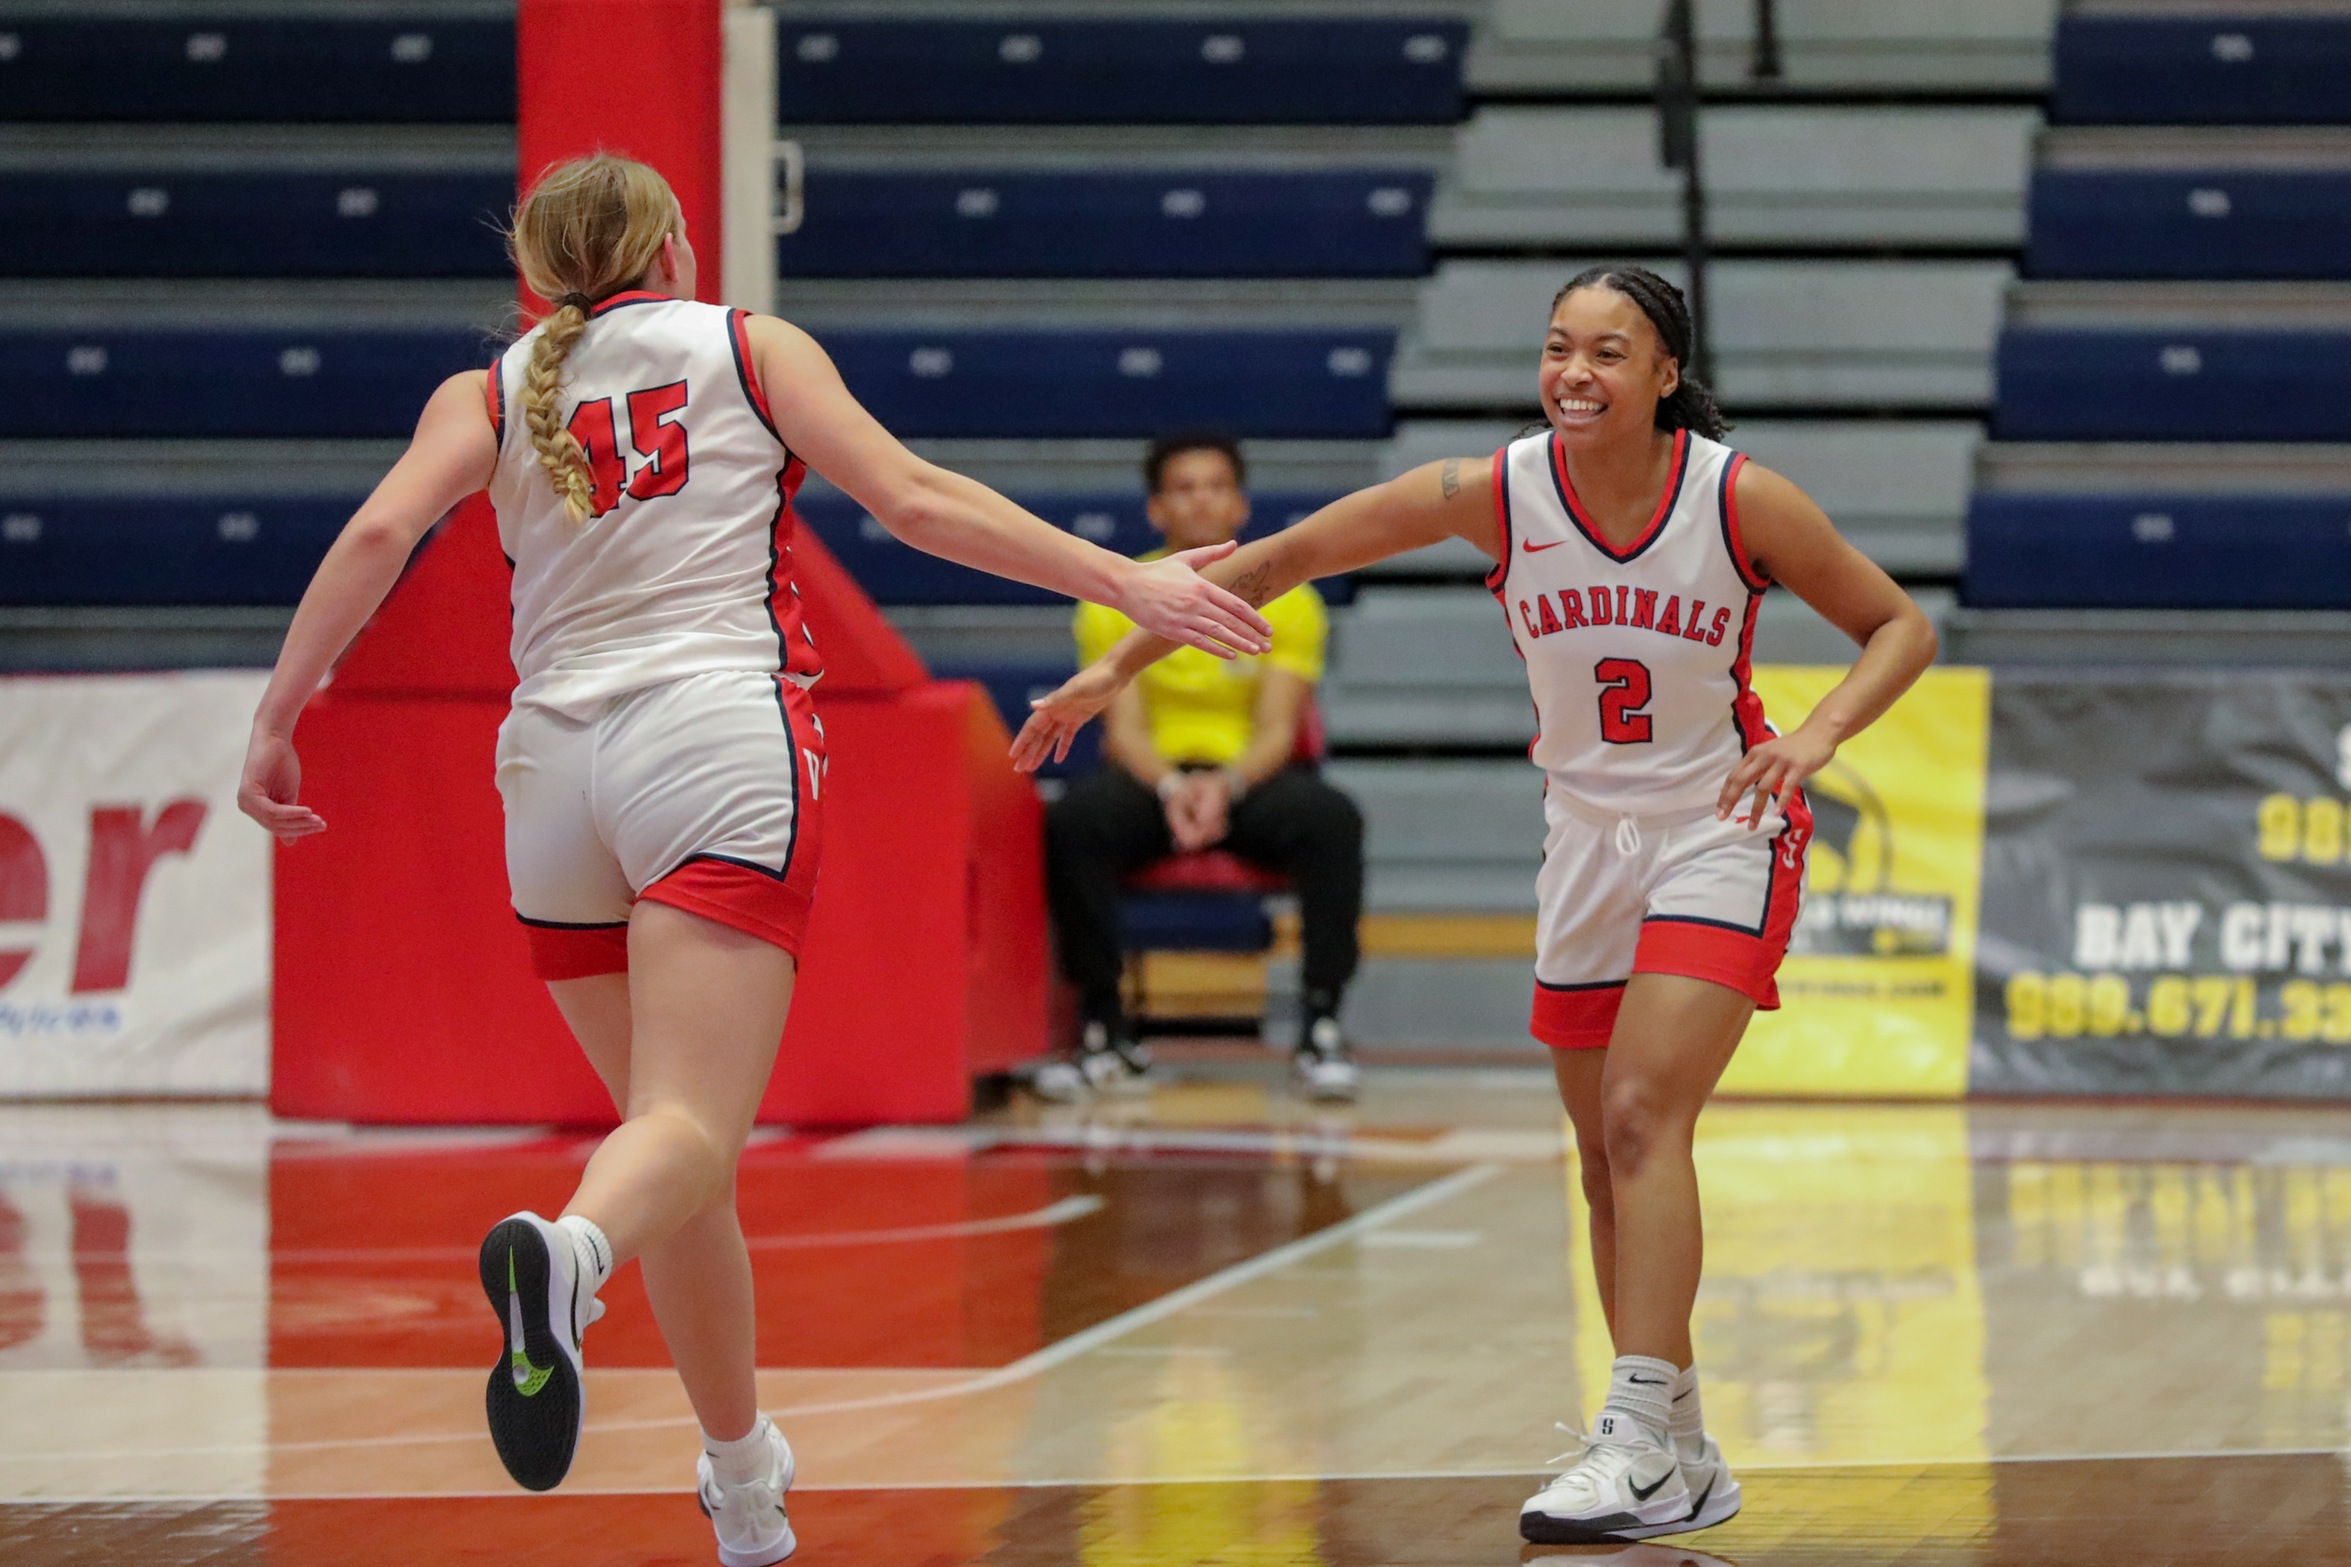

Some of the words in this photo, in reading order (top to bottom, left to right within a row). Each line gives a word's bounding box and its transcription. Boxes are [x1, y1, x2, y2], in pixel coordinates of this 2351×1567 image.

[566, 378, 689, 519] 45
[1519, 585, 1732, 647] CARDINALS
[1594, 657, 1653, 744] 2
[2257, 793, 2351, 867] 98
[2074, 902, 2200, 970] BAY
